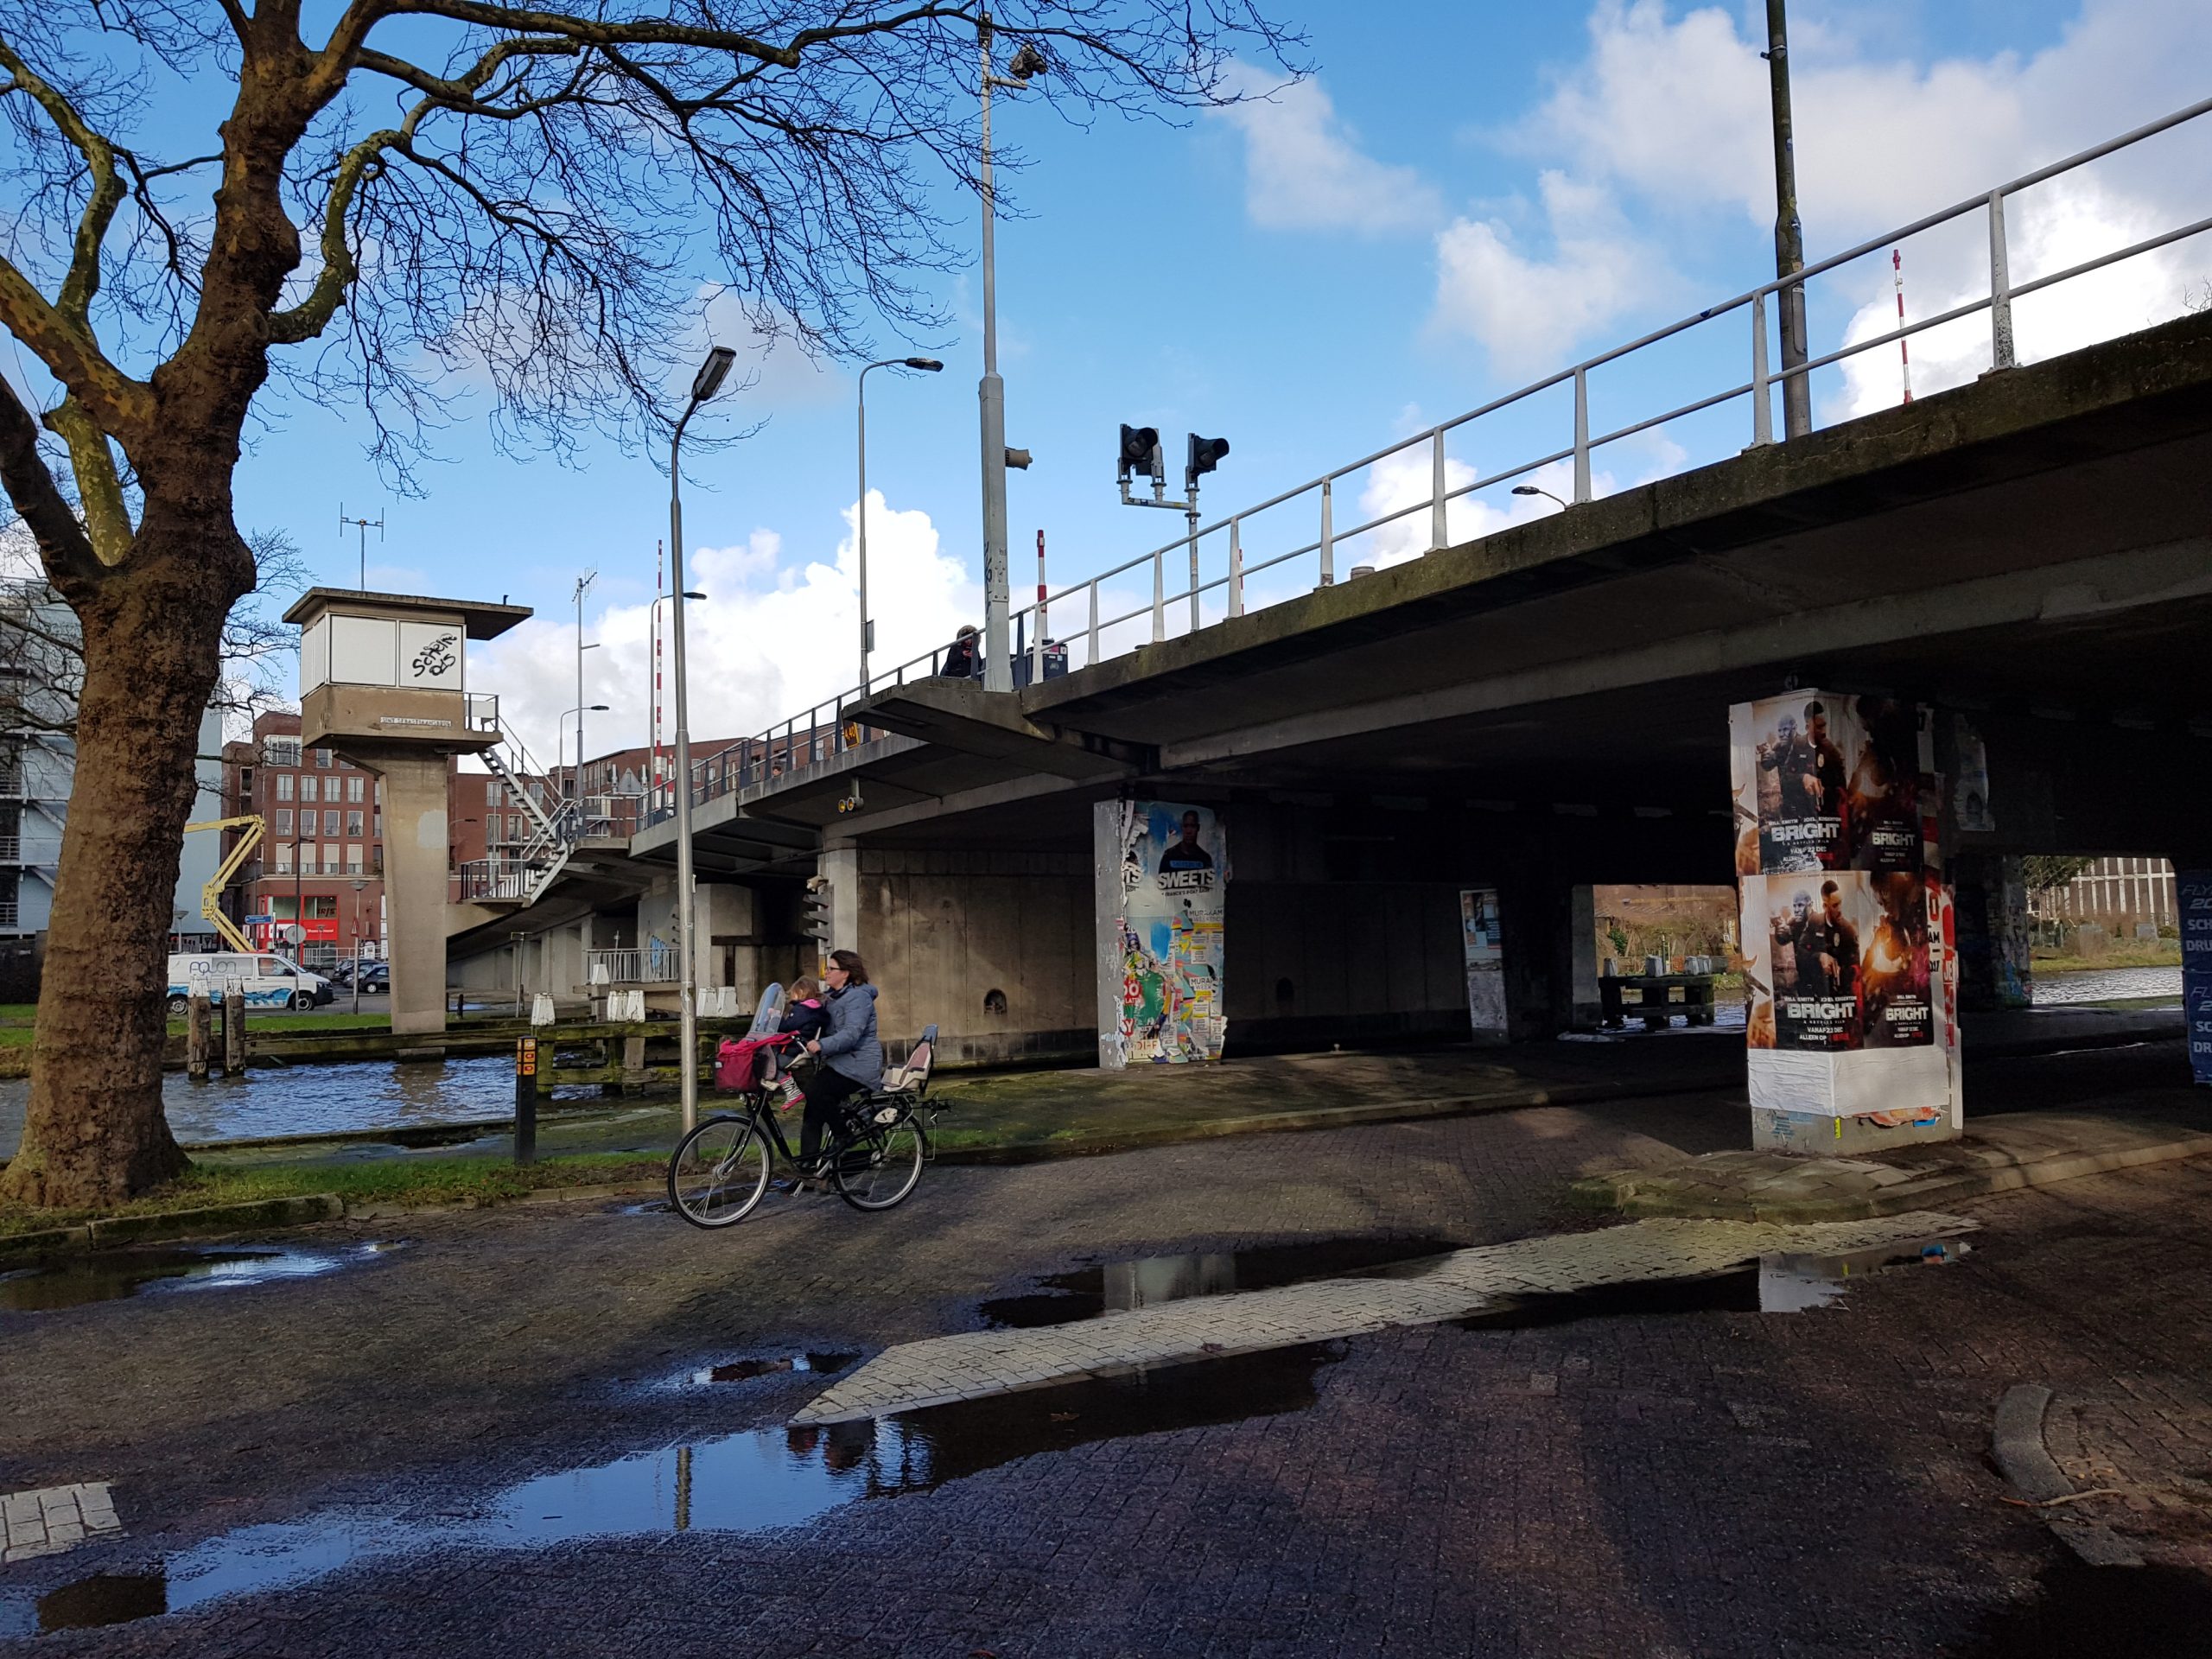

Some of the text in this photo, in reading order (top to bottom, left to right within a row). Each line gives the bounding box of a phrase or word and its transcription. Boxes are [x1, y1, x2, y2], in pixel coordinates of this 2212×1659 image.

[1771, 823, 1840, 842] BRIGHT
[1872, 832, 1916, 846] BRIGHT
[1159, 868, 1216, 889] SWEETS
[1787, 1002, 1855, 1020] BRIGHT
[1885, 1007, 1929, 1021] BRIGHT
